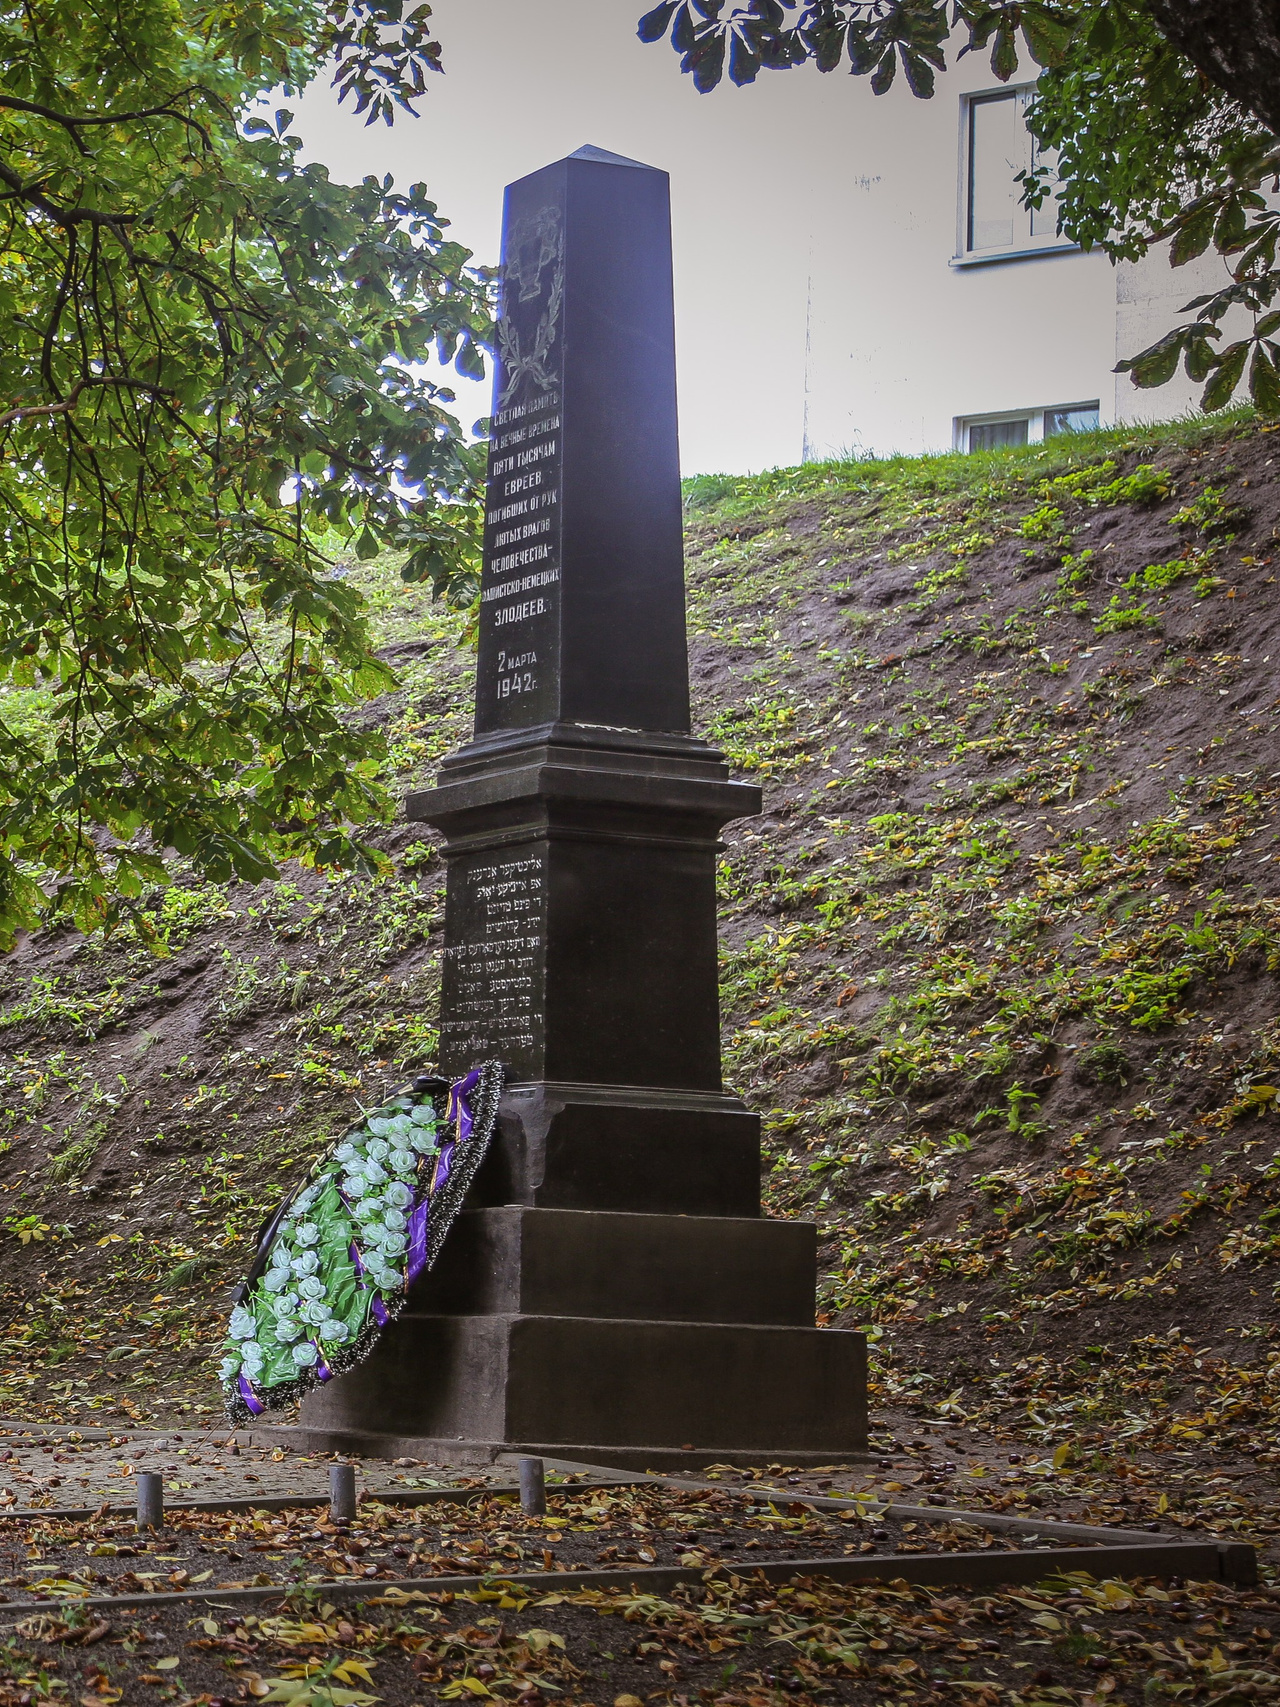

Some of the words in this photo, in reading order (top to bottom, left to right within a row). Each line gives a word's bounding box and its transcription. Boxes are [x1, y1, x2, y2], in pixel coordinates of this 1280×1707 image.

[494, 402, 527, 427] СВЕТЛАЯ
[489, 438, 499, 453] НА
[500, 427, 527, 449] ВЕЧНЫЕ
[528, 415, 560, 438] ВРЕМЕНА
[493, 455, 514, 476] ПЯТИ
[517, 440, 556, 467] ТЫСЯЧАМ
[488, 499, 528, 525] ПОГИБШИХ
[530, 495, 540, 511] ОТ
[541, 489, 557, 508] РУК
[494, 524, 522, 549] ЛЮТЫХ
[522, 518, 551, 537] ВРАГОВ
[498, 651, 506, 672] 2
[507, 651, 537, 669] МАРТА
